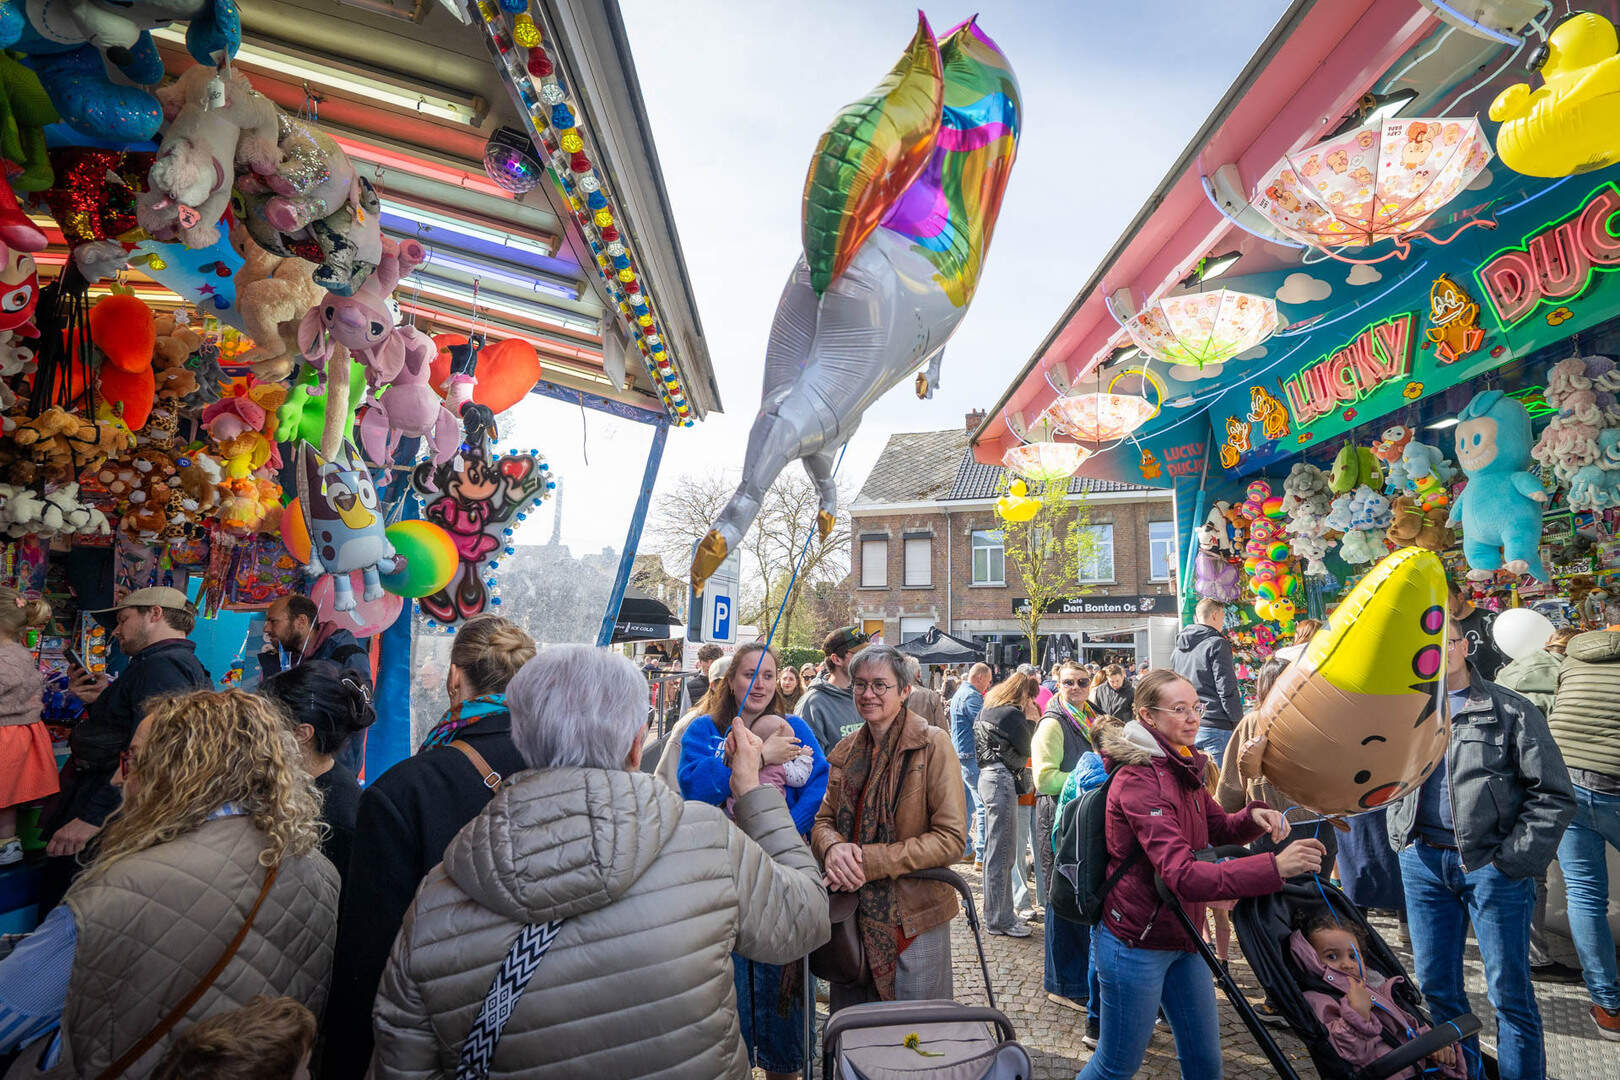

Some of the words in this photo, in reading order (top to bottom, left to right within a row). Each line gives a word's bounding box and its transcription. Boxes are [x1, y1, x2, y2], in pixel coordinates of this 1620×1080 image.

[1285, 315, 1414, 424] LUCKY
[1163, 442, 1205, 462] LUCKY
[715, 602, 729, 633] P
[1063, 604, 1083, 612] Den
[1085, 603, 1121, 612] Bonten
[1124, 603, 1137, 612] Os
